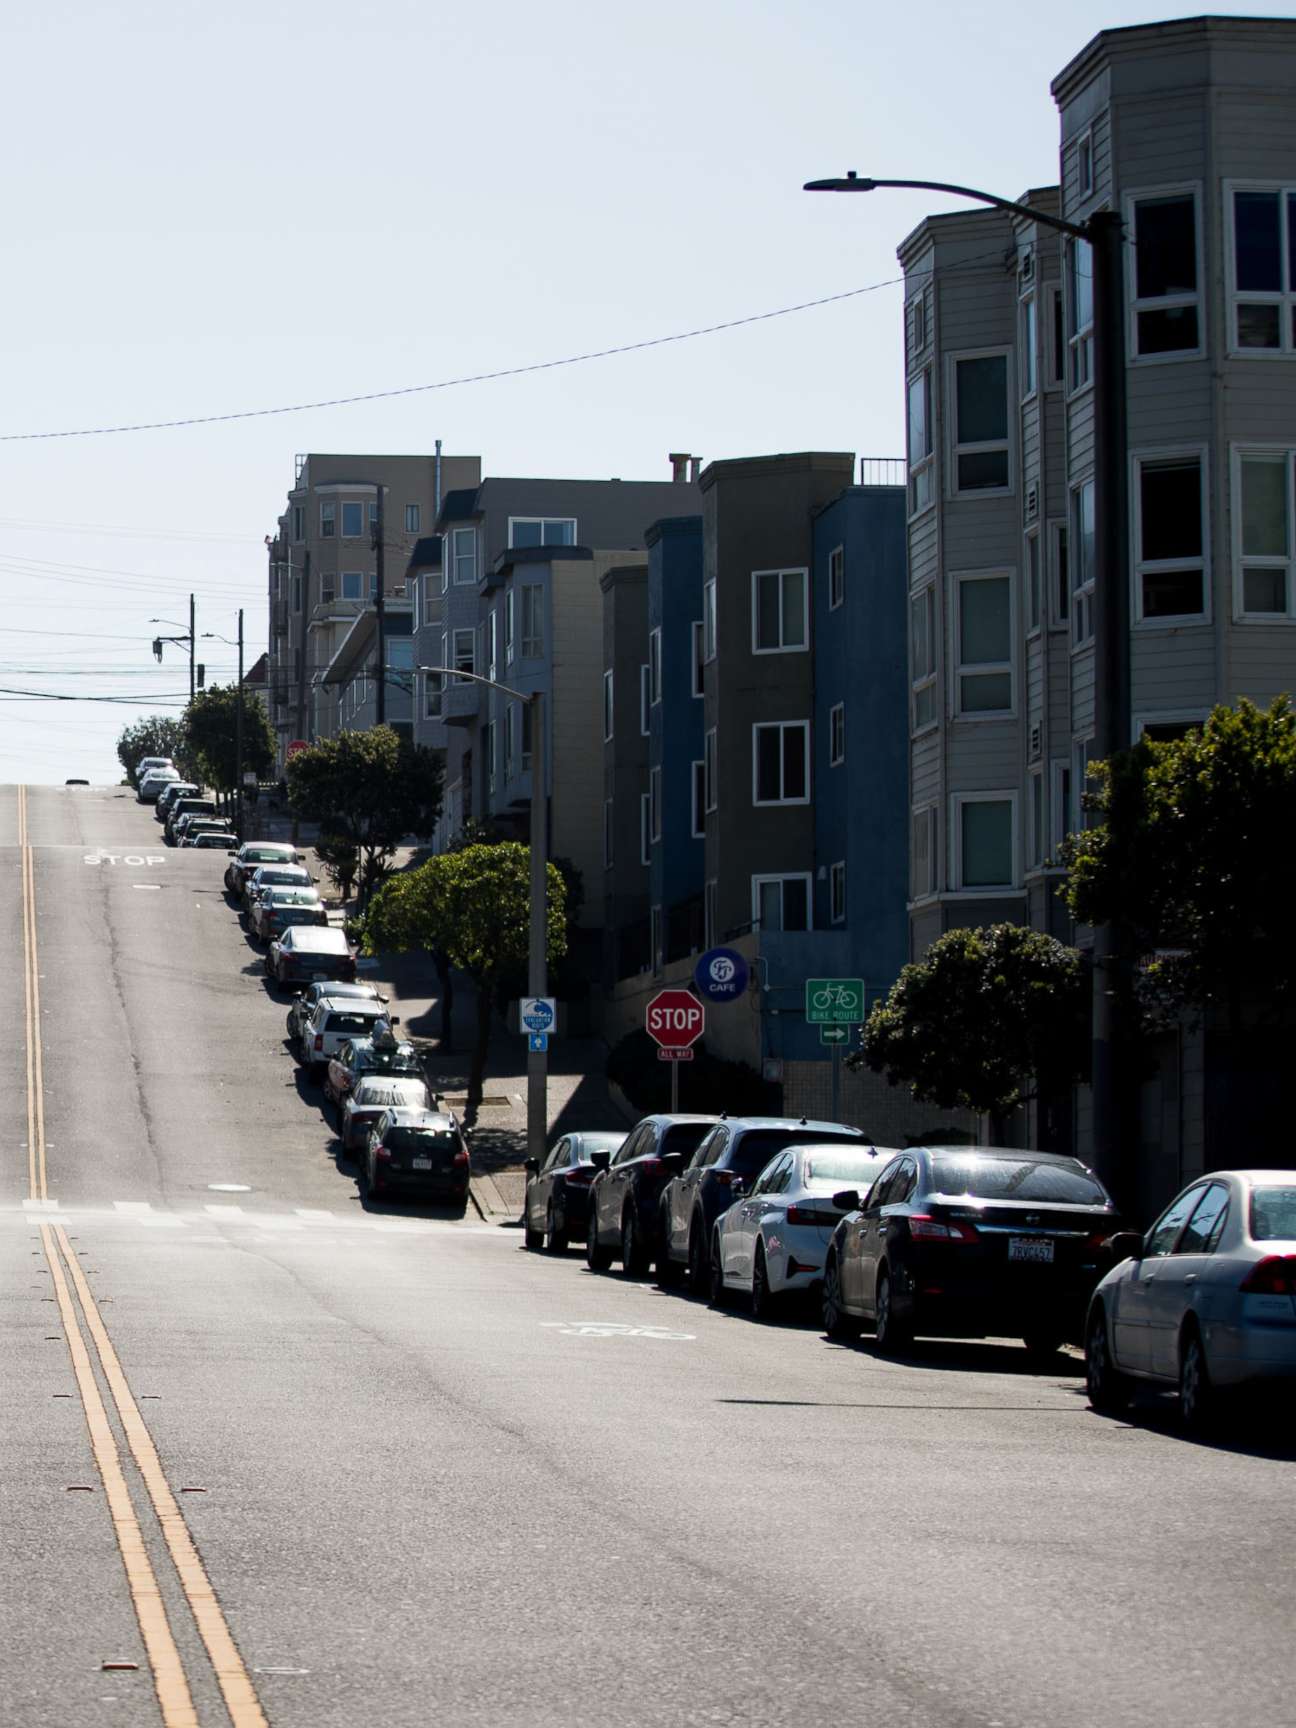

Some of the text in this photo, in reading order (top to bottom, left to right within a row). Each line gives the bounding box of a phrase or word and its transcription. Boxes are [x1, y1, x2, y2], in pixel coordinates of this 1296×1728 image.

[83, 855, 166, 866] STOP
[709, 983, 736, 992] CAFE
[650, 1008, 700, 1030] STOP
[812, 1011, 858, 1020] BIKE ROUTE
